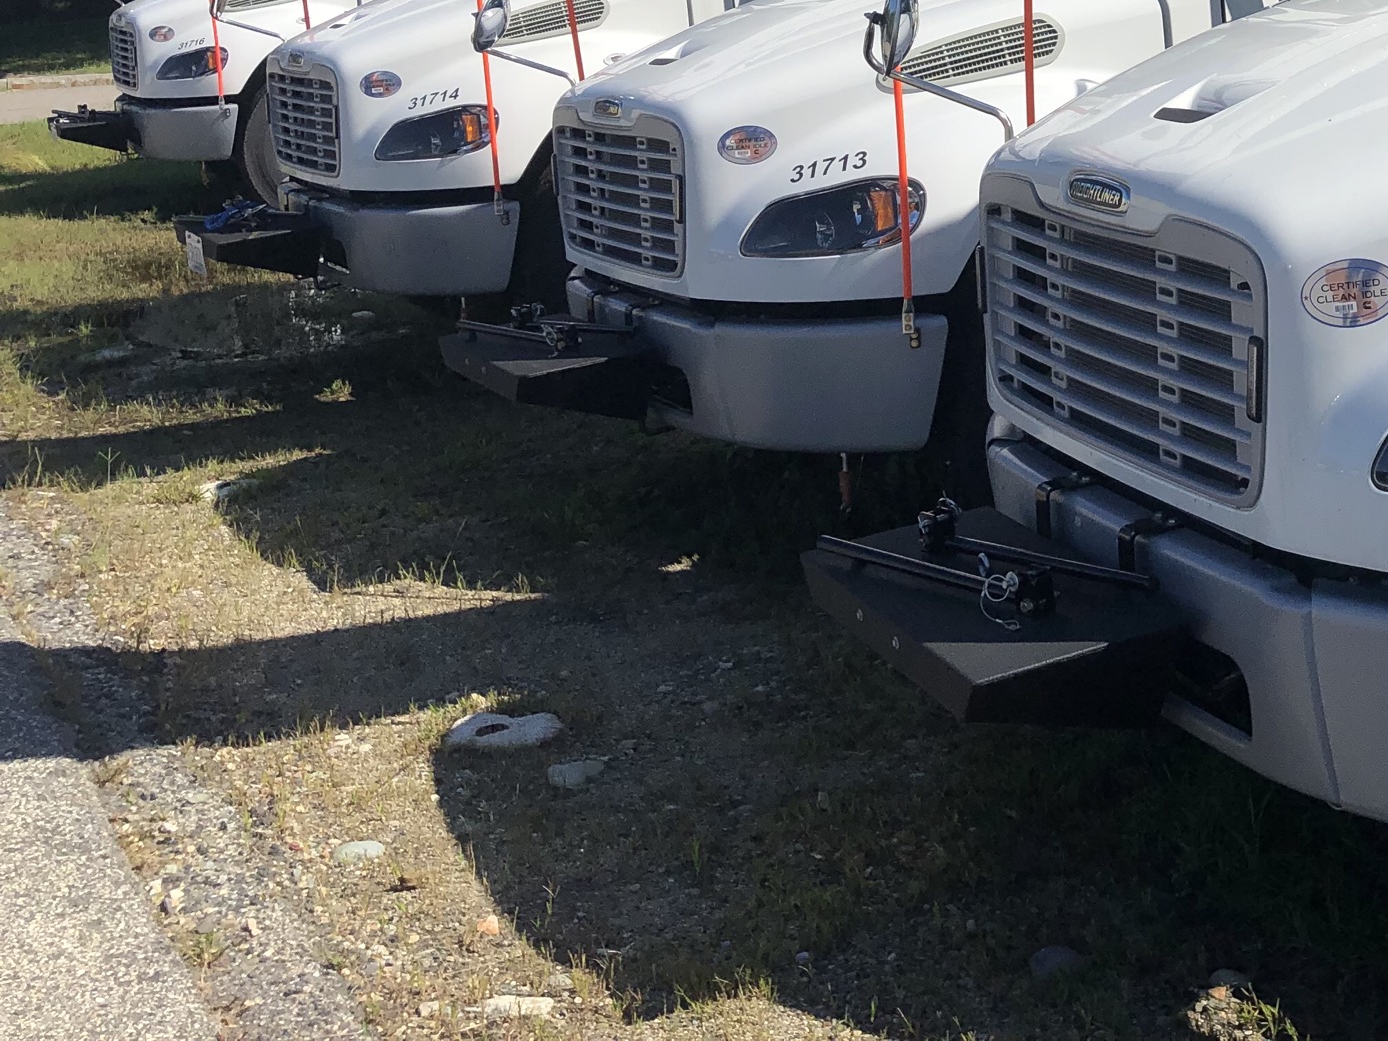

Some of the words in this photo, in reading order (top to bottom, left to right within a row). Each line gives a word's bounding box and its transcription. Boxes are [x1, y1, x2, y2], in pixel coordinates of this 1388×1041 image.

[177, 38, 206, 51] 31716
[407, 87, 460, 110] 31714
[789, 150, 868, 184] 31713
[1320, 278, 1381, 293] CERTIFIED
[1316, 292, 1357, 305] CLEAN
[1361, 288, 1388, 300] IDLE
